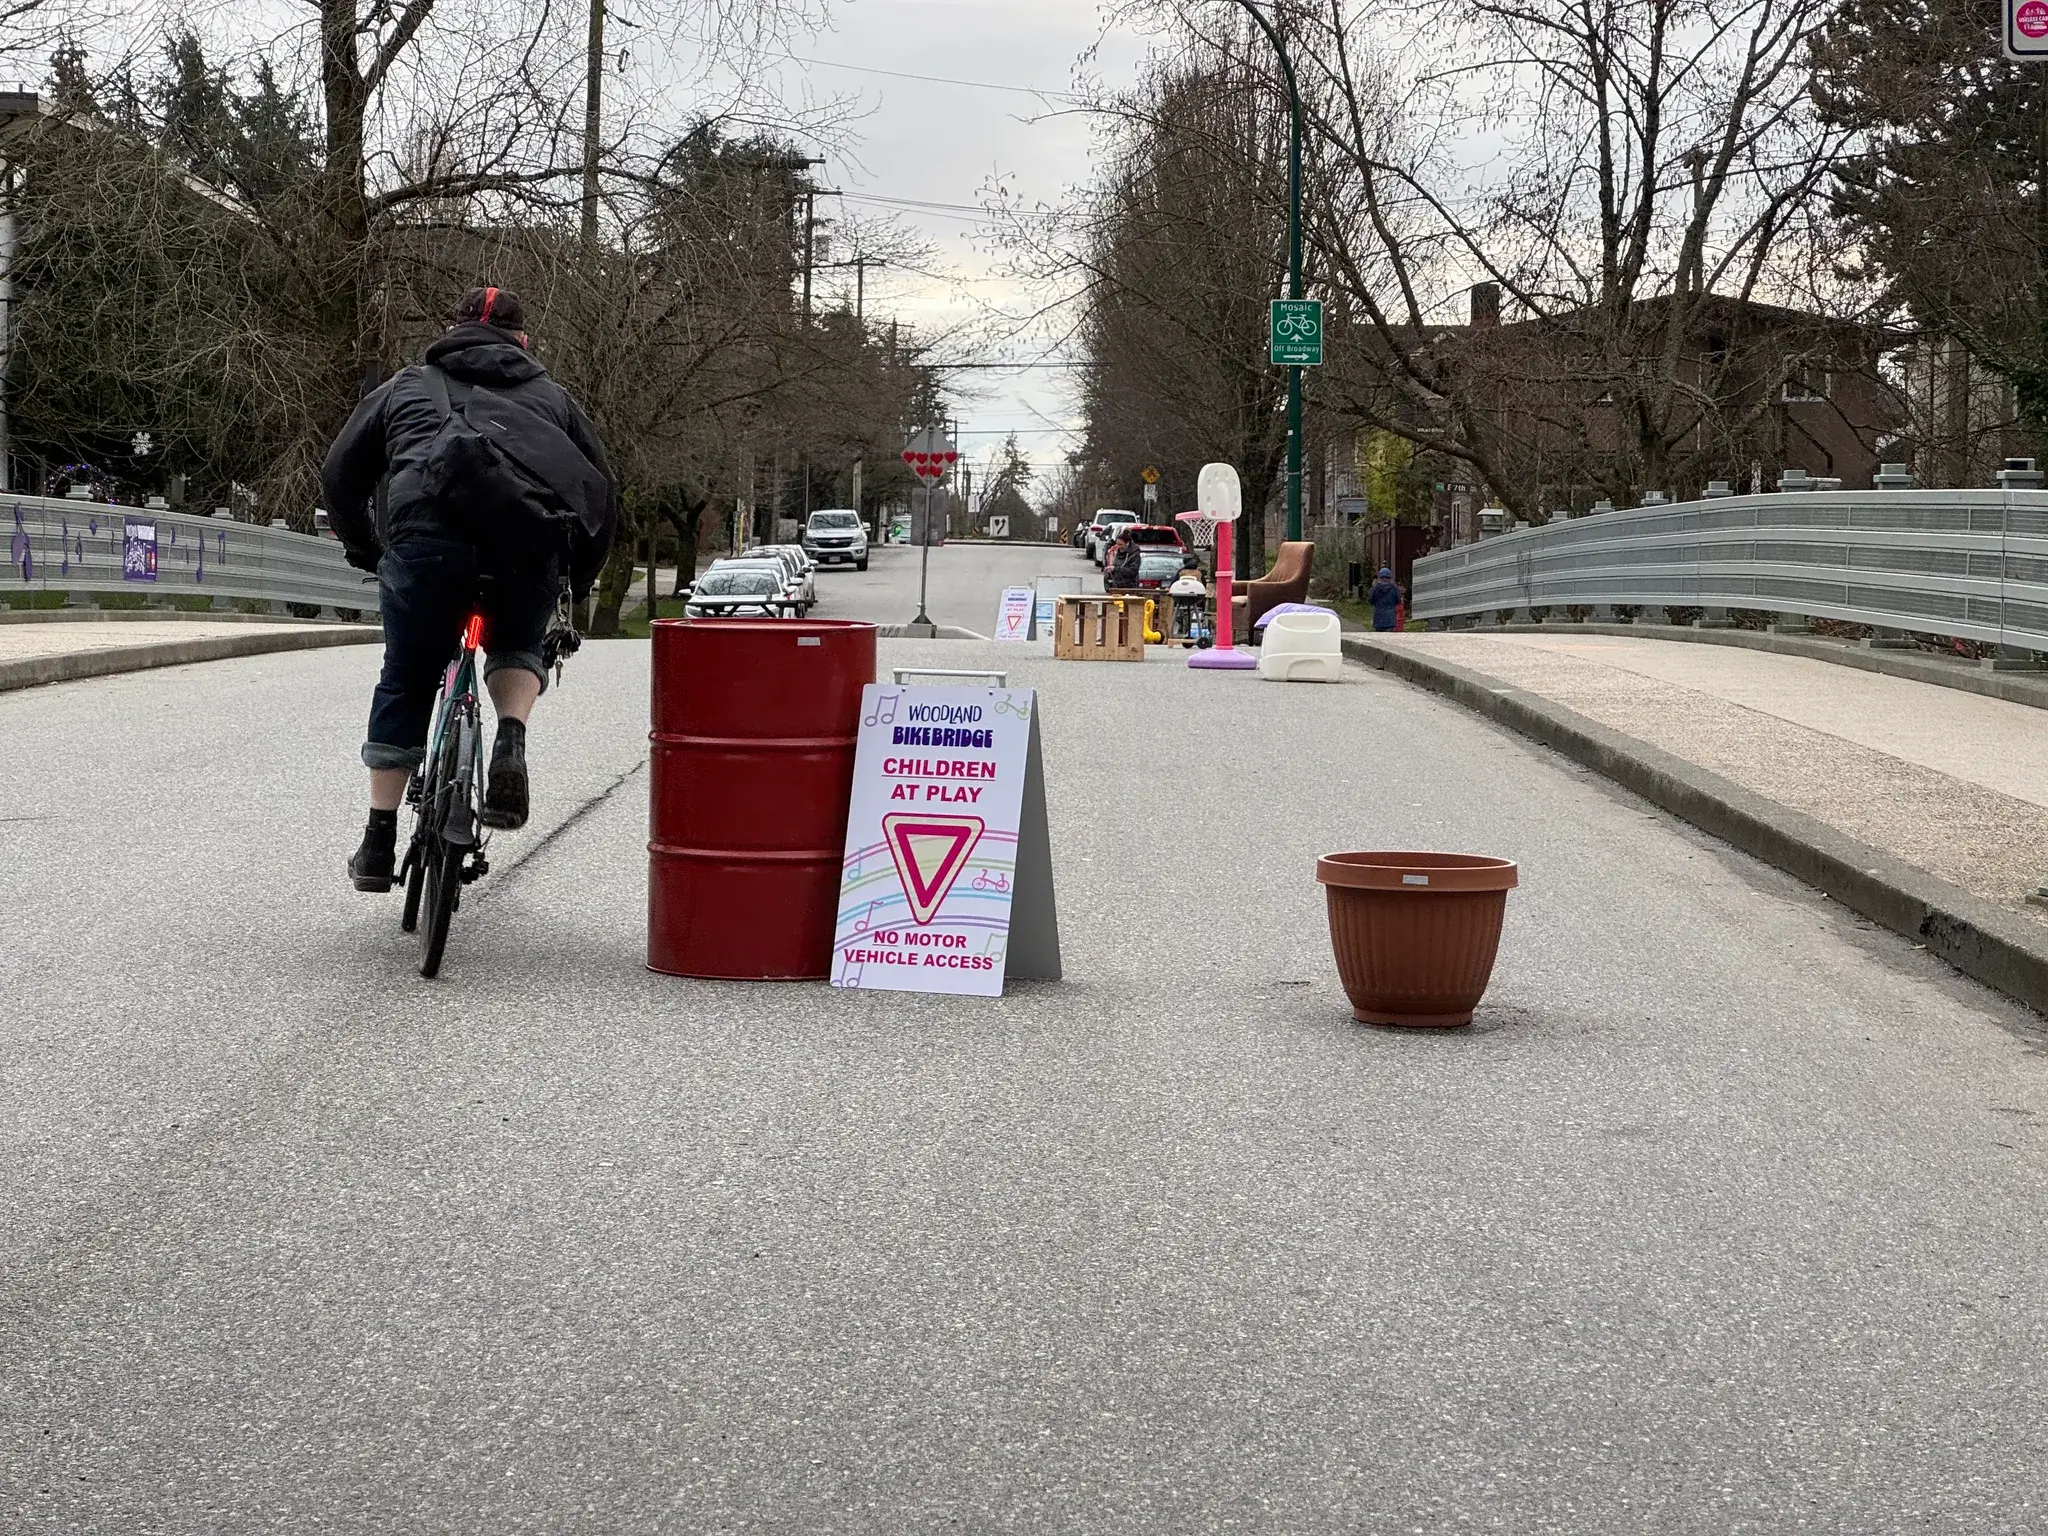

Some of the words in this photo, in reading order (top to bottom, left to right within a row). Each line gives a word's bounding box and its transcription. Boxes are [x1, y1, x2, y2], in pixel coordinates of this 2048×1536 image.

[1280, 303, 1313, 311] Mosaic
[1286, 345, 1320, 354] Broadway
[1454, 484, 1466, 492] 7th
[909, 703, 982, 724] WOODLAND
[892, 726, 994, 748] BIKEBRIDGE
[883, 758, 996, 778] CHILDREN
[891, 783, 919, 801] AT
[926, 784, 983, 803] PLAY
[873, 930, 899, 944] NO
[904, 933, 967, 948] MOTOR
[844, 949, 918, 966] VEHICLE
[923, 953, 993, 970] ACCESS
